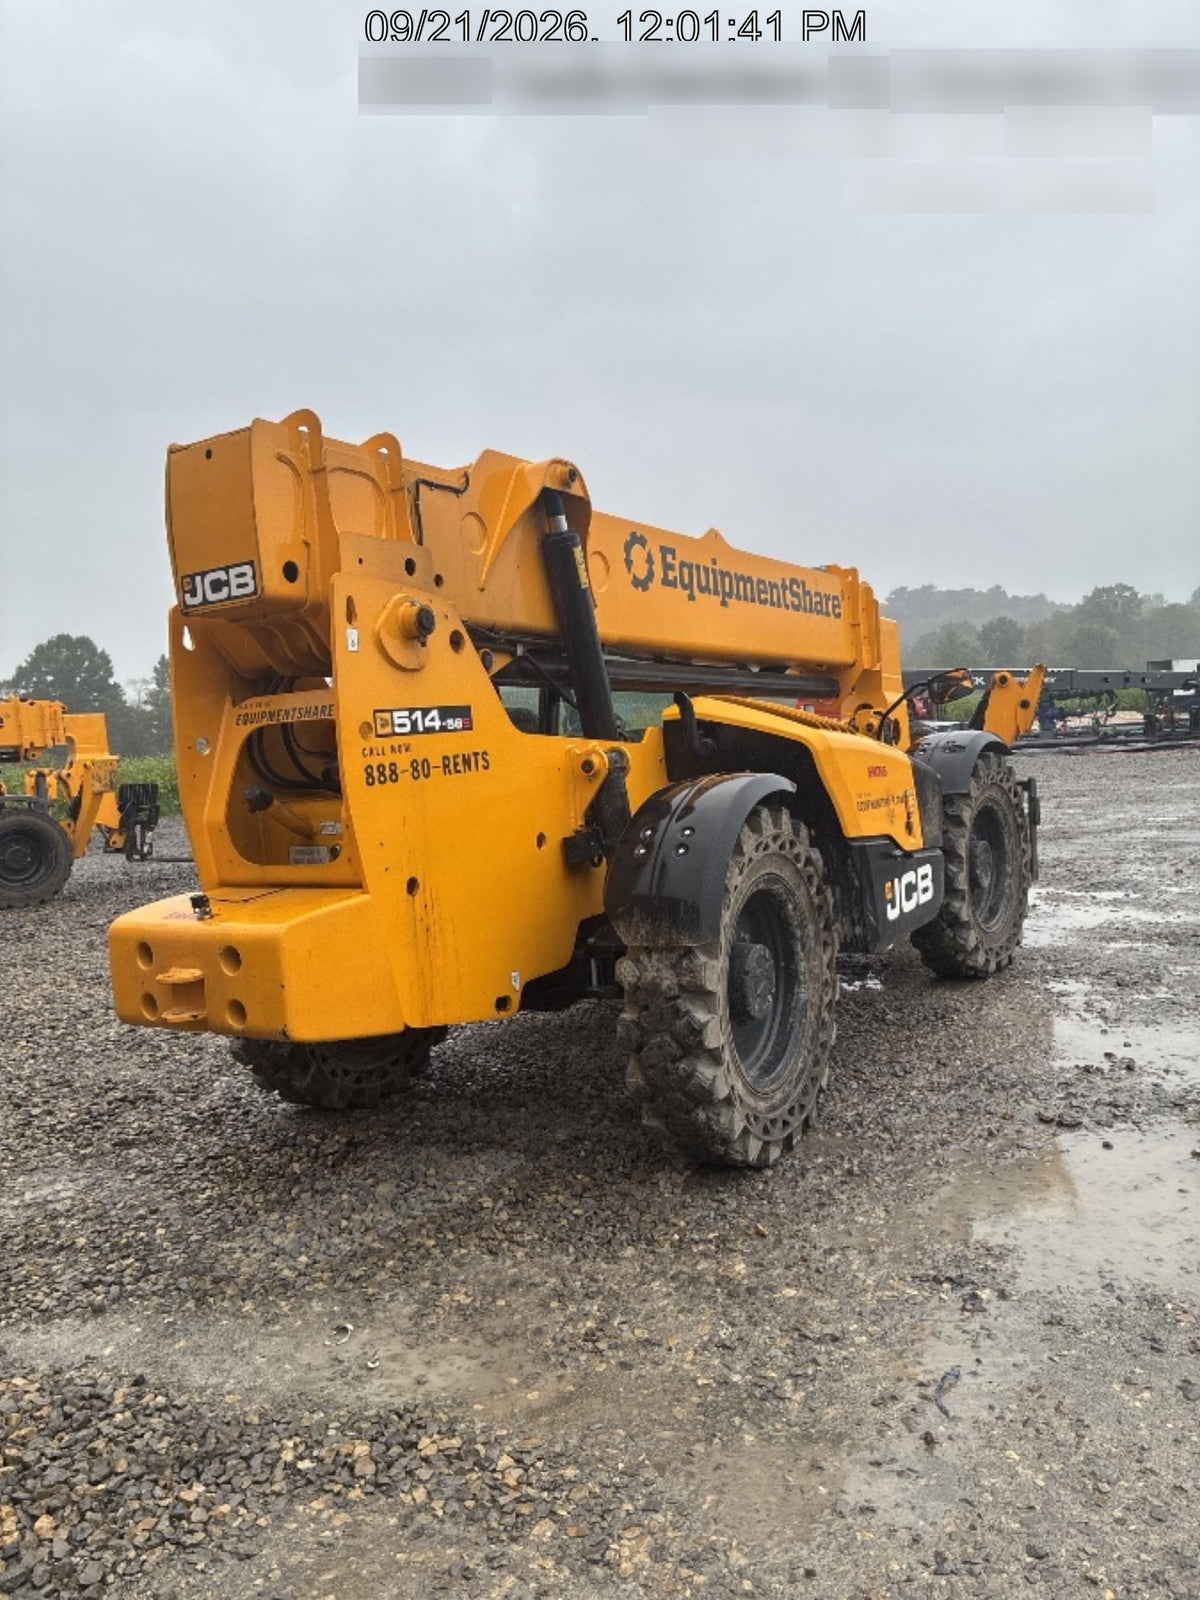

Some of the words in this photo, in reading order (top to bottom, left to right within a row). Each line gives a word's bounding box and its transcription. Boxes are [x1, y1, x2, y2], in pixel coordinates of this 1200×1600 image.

[184, 564, 255, 606] JCB
[659, 544, 842, 619] EquipmentShare
[235, 703, 335, 726] EQUIPMENTSHARE
[361, 746, 387, 758] CALL
[364, 750, 491, 787] 888-80-RENTS
[886, 863, 934, 921] JCB
